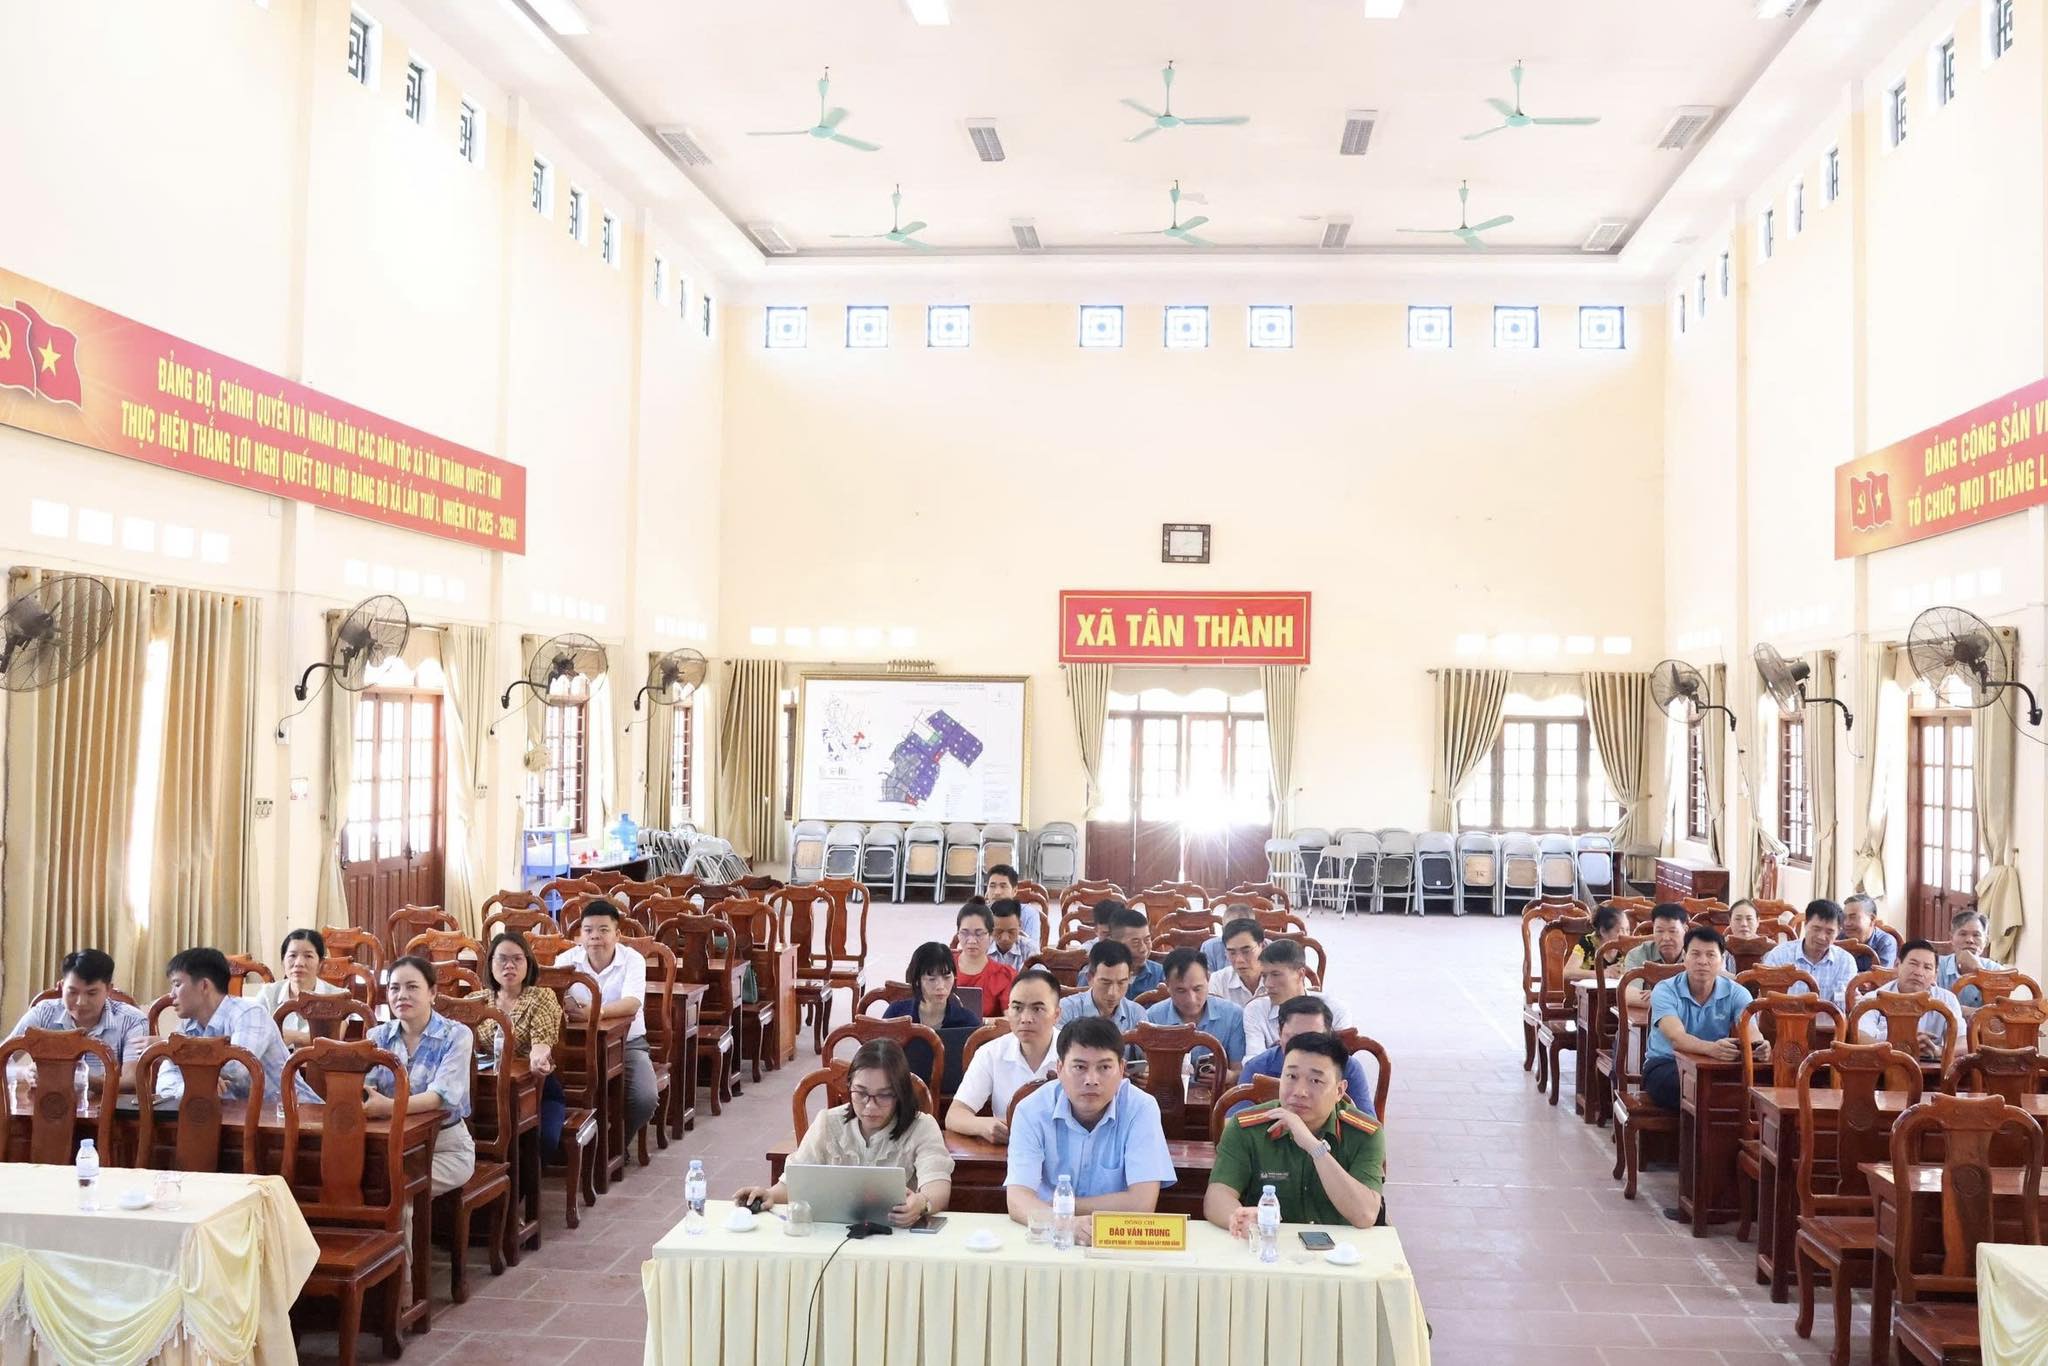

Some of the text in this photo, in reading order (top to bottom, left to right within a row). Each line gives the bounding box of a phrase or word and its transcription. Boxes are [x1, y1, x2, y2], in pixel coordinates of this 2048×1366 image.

[158, 350, 192, 400] ĐẢNG
[219, 378, 254, 421] CHÍNH
[293, 401, 306, 438] VÀ
[308, 410, 335, 448] NHÂN
[337, 417, 356, 454] DÂN
[358, 425, 376, 460] CÁC
[1925, 433, 1957, 477] ĐẢNG
[1961, 423, 1997, 467] CỘNG
[2001, 401, 2031, 448] SẢN
[121, 400, 156, 448] THỰC
[159, 410, 189, 457] HIỆN
[193, 415, 231, 465] THẮNG
[234, 434, 251, 476] LỢI
[254, 441, 280, 485] NGHỊ
[283, 447, 313, 487] QUYẾT
[315, 459, 331, 497] ĐẠI
[333, 462, 349, 503] HỘI
[351, 464, 375, 504] ĐẢNG
[376, 474, 388, 514] BỘ
[390, 479, 400, 512] XÃ
[1908, 485, 1922, 527] TỔ
[1925, 482, 1956, 523] CHỨC
[1960, 475, 1985, 515] MỌI
[1988, 452, 2035, 503] THẮNG
[1076, 608, 1294, 648] XÃ TÂN THÀNH
[1127, 1227, 1143, 1237] VĂN
[1145, 1228, 1170, 1237] TRUNG
